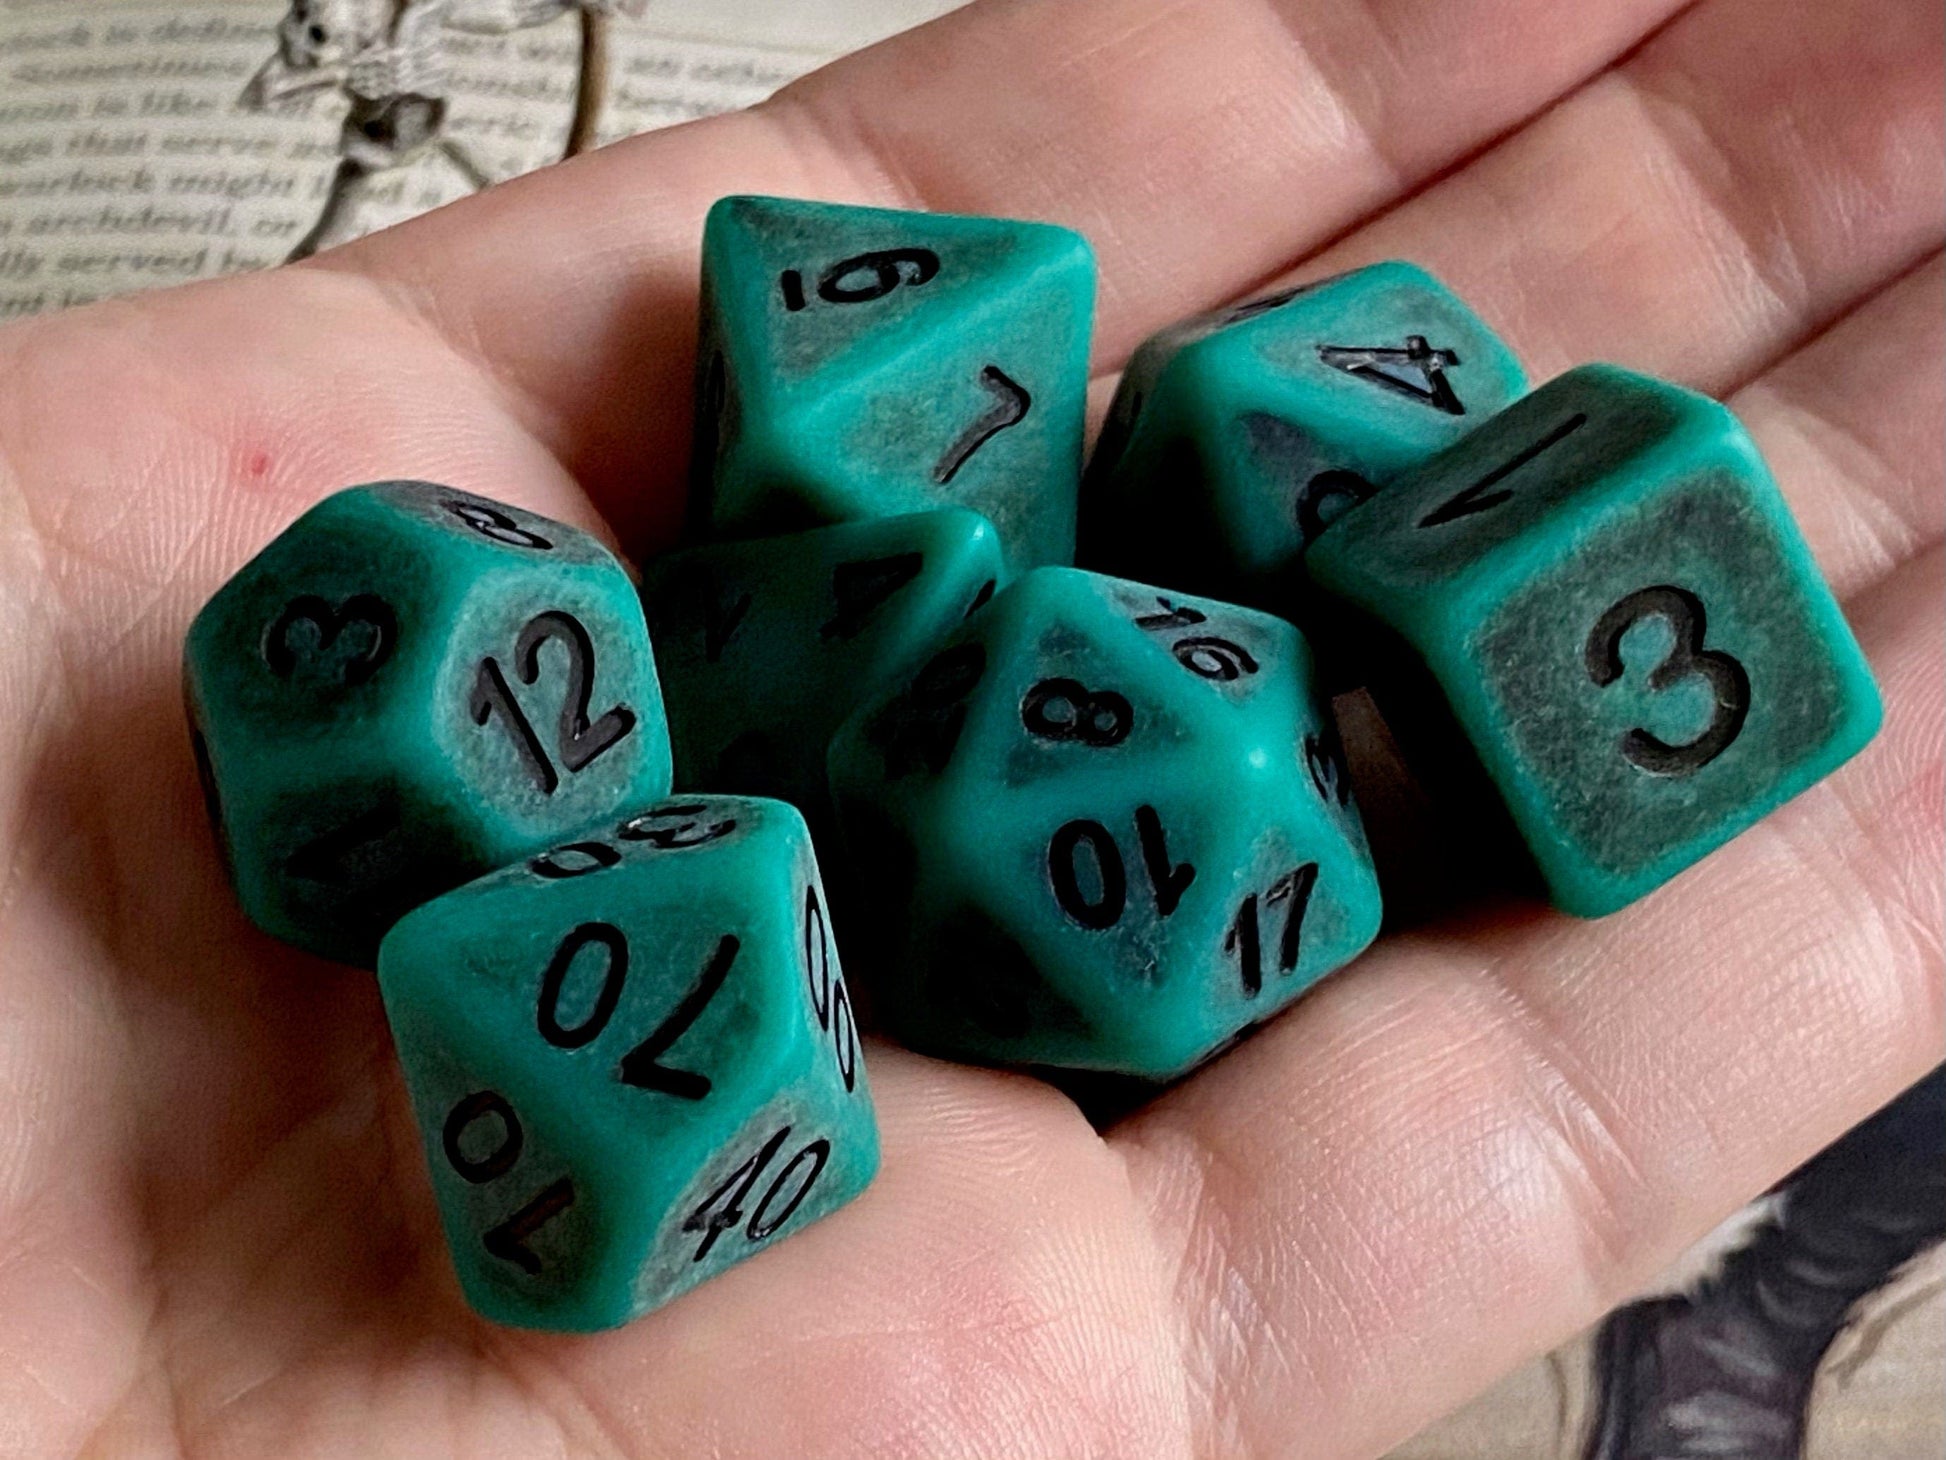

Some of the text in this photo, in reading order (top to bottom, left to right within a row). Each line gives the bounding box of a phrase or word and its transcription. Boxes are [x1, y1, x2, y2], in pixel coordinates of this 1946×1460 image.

[932, 364, 1032, 484] 7
[1315, 335, 1465, 415] 4
[1417, 412, 1587, 529] 1
[259, 593, 399, 688] 3
[469, 610, 637, 796] 12
[1584, 584, 1752, 778] 3
[1020, 677, 1135, 747] 8
[1047, 804, 1196, 931] 10
[1223, 861, 1320, 1001] 17
[536, 920, 741, 1101] 70
[441, 1089, 576, 1276] 10
[681, 1125, 831, 1264] 40
